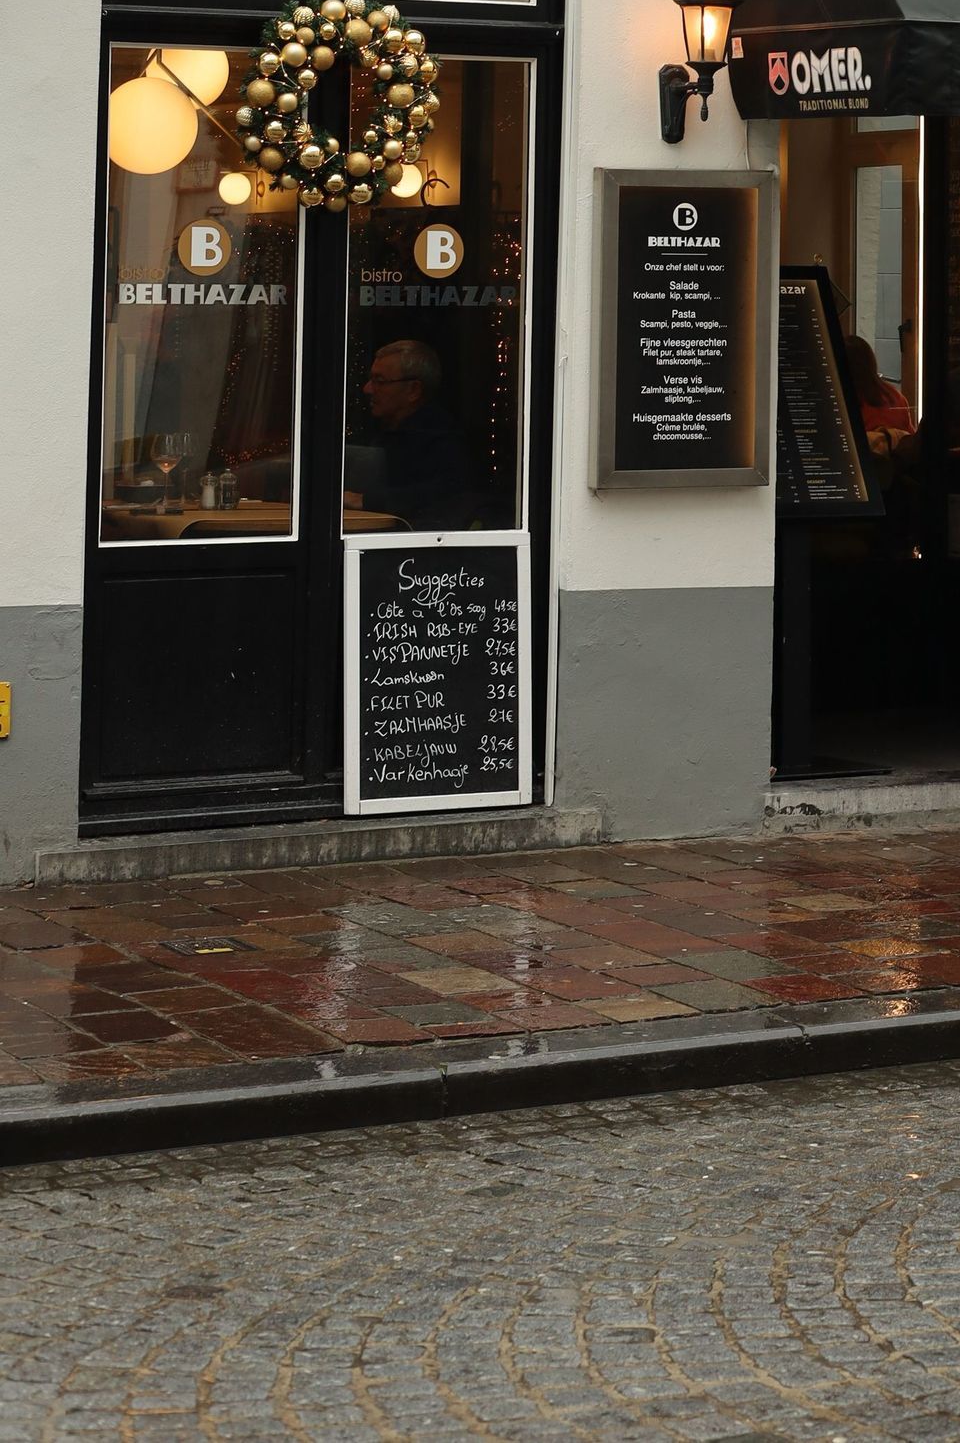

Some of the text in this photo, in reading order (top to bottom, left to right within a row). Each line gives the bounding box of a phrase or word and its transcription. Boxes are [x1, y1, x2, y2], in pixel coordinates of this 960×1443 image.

[799, 97, 869, 111] TRADITIONAL BLOND
[677, 207, 695, 227] B
[191, 226, 223, 267] B
[647, 236, 721, 248] BELTHAZAR
[426, 230, 457, 270] B
[644, 263, 725, 272] Onze chef stelt u voor:
[361, 268, 403, 283] bistro
[669, 280, 700, 291] Salade
[119, 283, 288, 305] BELTHAZAR
[360, 285, 517, 307] BELTHAZAR
[633, 291, 666, 300] Krokante
[669, 291, 683, 301] kip,
[684, 291, 713, 301] scampi,
[671, 309, 697, 319] Pasta
[640, 320, 670, 329] Scampi,
[671, 320, 694, 329] pesto,
[640, 337, 728, 349] Fijne vleesgerechten
[642, 348, 723, 358] Filet pur, steak tartare,
[663, 375, 703, 385] Verse vis
[641, 386, 725, 395] Zalmhaasje, kabeljauw,
[632, 412, 732, 424] Huisgemaakte desserts
[656, 423, 708, 432] Crème brulée,
[399, 558, 485, 602] Suggesties
[377, 601, 405, 619] Côte
[373, 617, 518, 642] IRISH RIB-EYE 33€
[489, 661, 516, 676] 36€
[370, 684, 517, 712] FILET PUR 33€
[488, 707, 514, 723] 27€
[480, 756, 515, 773] 25,5€
